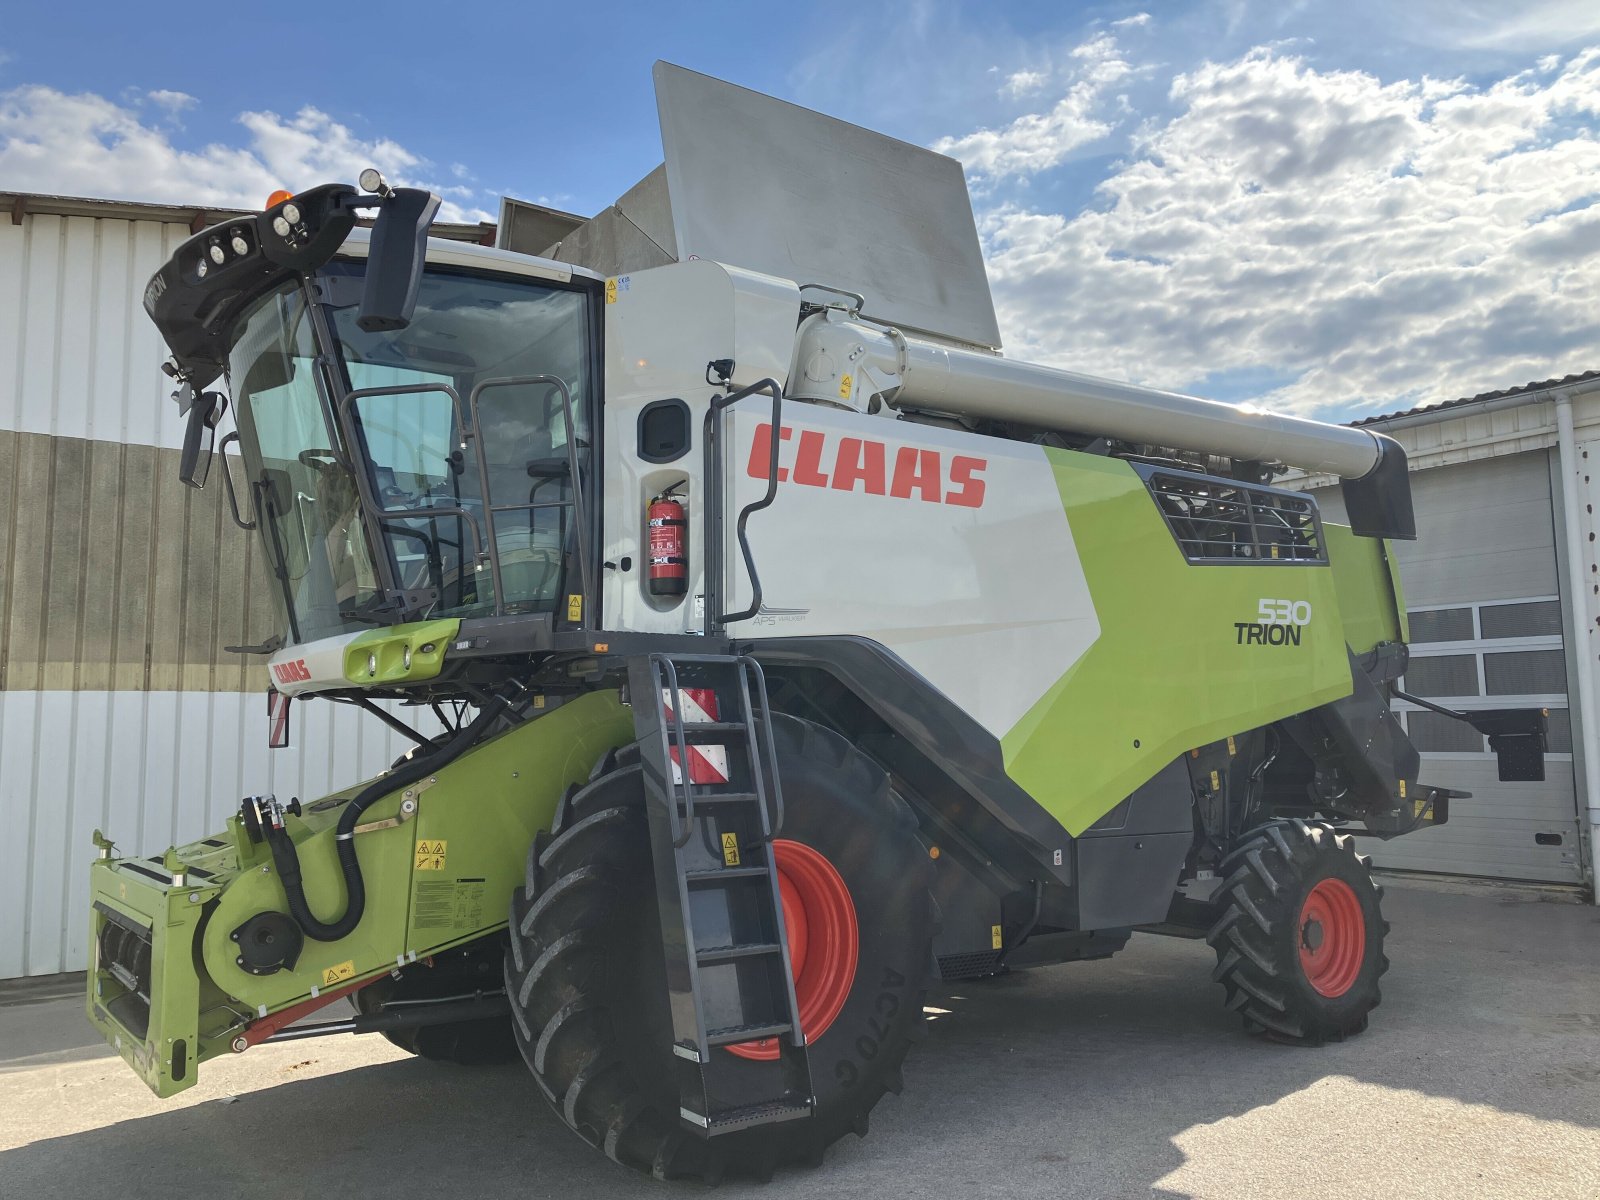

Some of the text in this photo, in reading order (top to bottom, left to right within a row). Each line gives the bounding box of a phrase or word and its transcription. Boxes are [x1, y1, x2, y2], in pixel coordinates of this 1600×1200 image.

[747, 423, 987, 508] CLAAS
[752, 616, 776, 626] APS
[1257, 598, 1312, 626] 530
[1234, 622, 1302, 646] TRION
[273, 659, 312, 684] CLAAS
